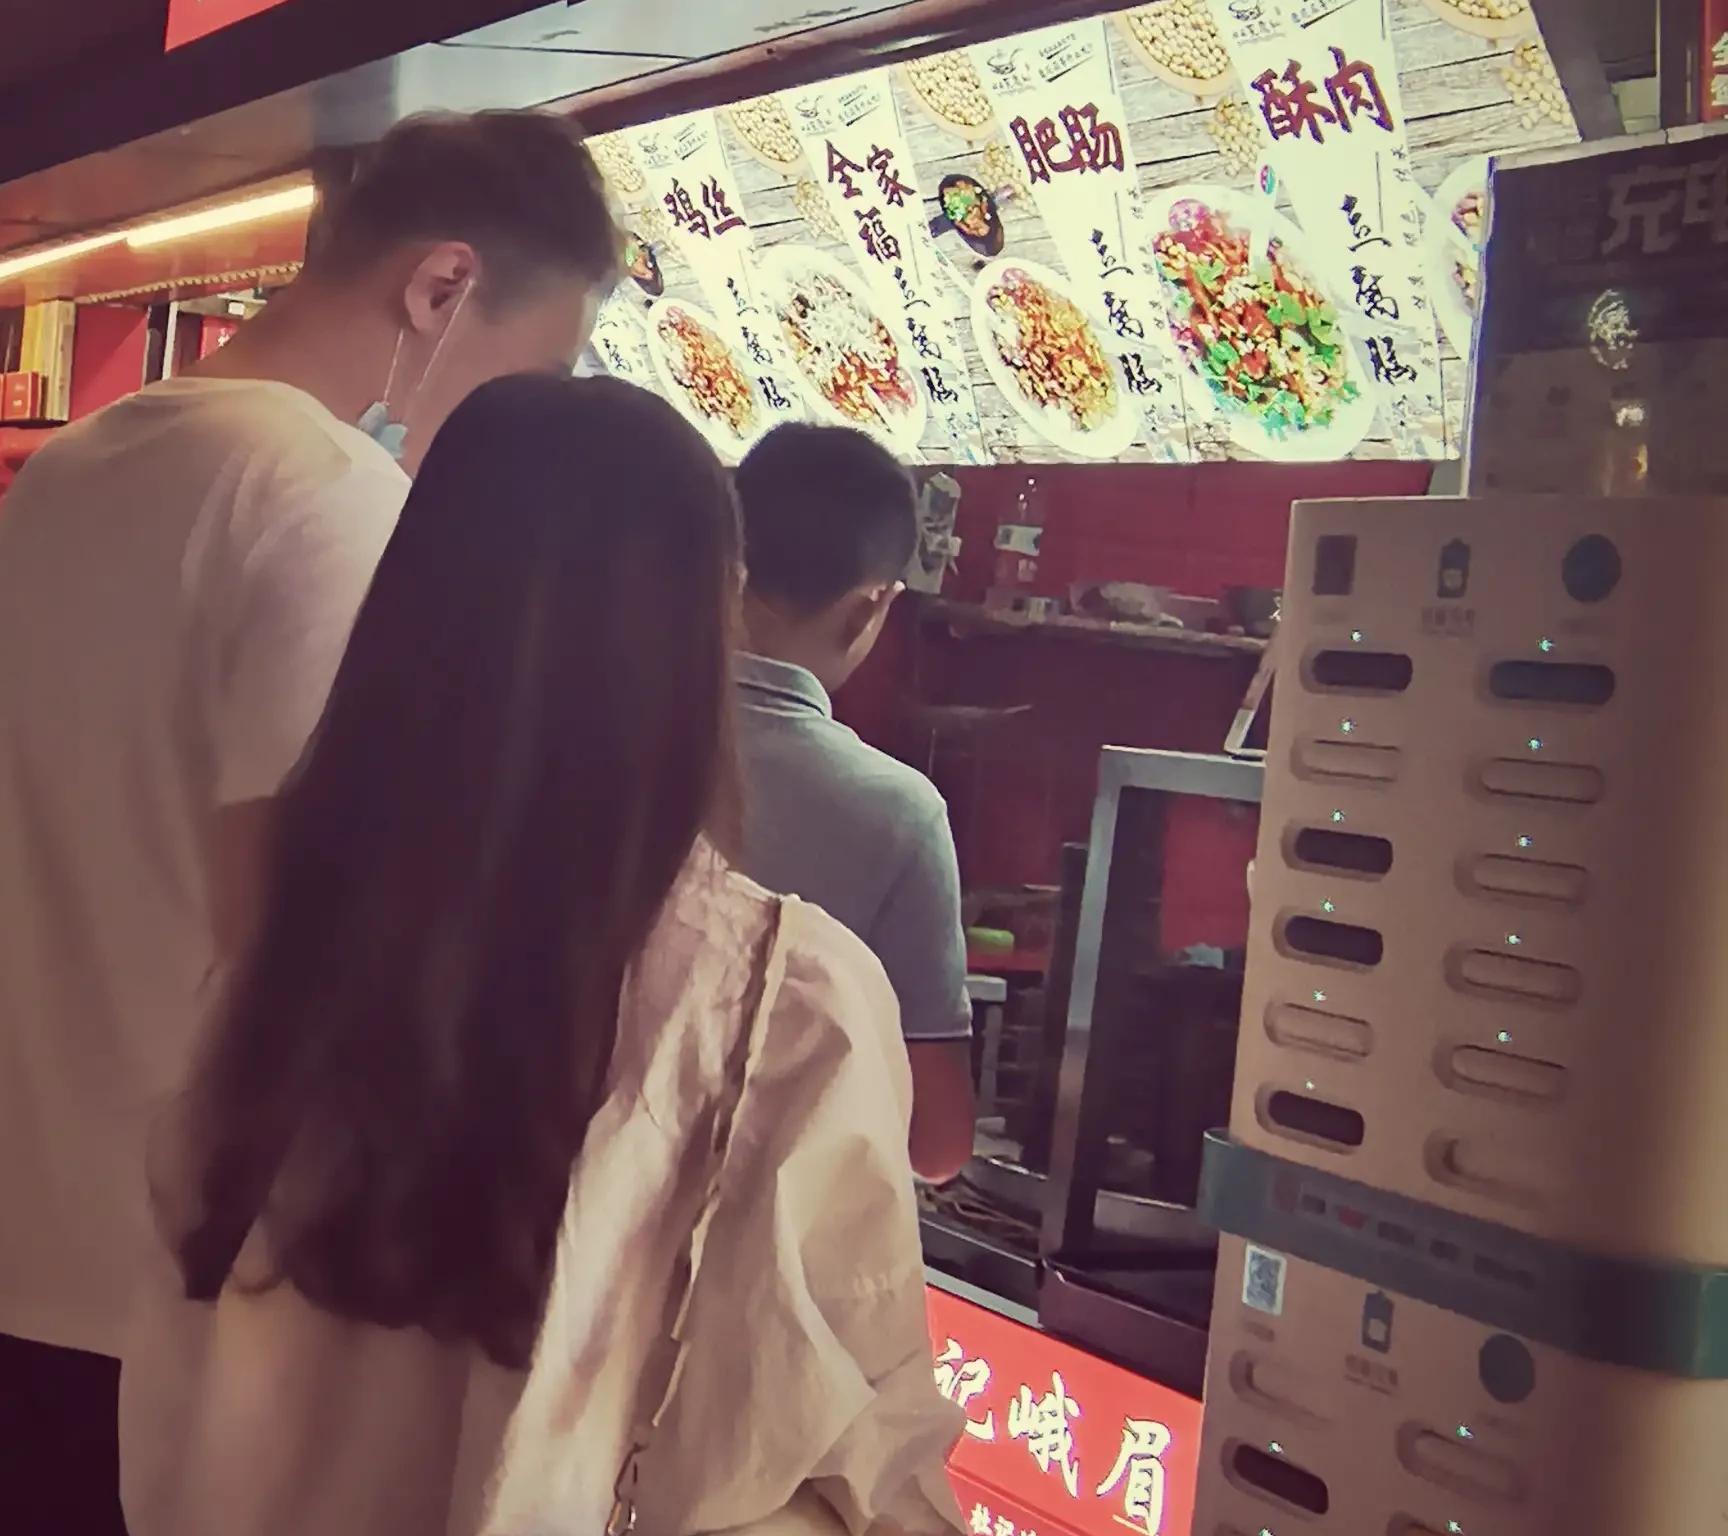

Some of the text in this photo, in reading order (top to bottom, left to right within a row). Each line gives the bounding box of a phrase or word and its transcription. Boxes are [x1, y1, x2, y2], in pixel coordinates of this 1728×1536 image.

[1251, 46, 1394, 149] 酥肉
[1009, 101, 1125, 185] 肥肠
[663, 174, 747, 241] 鸡丝
